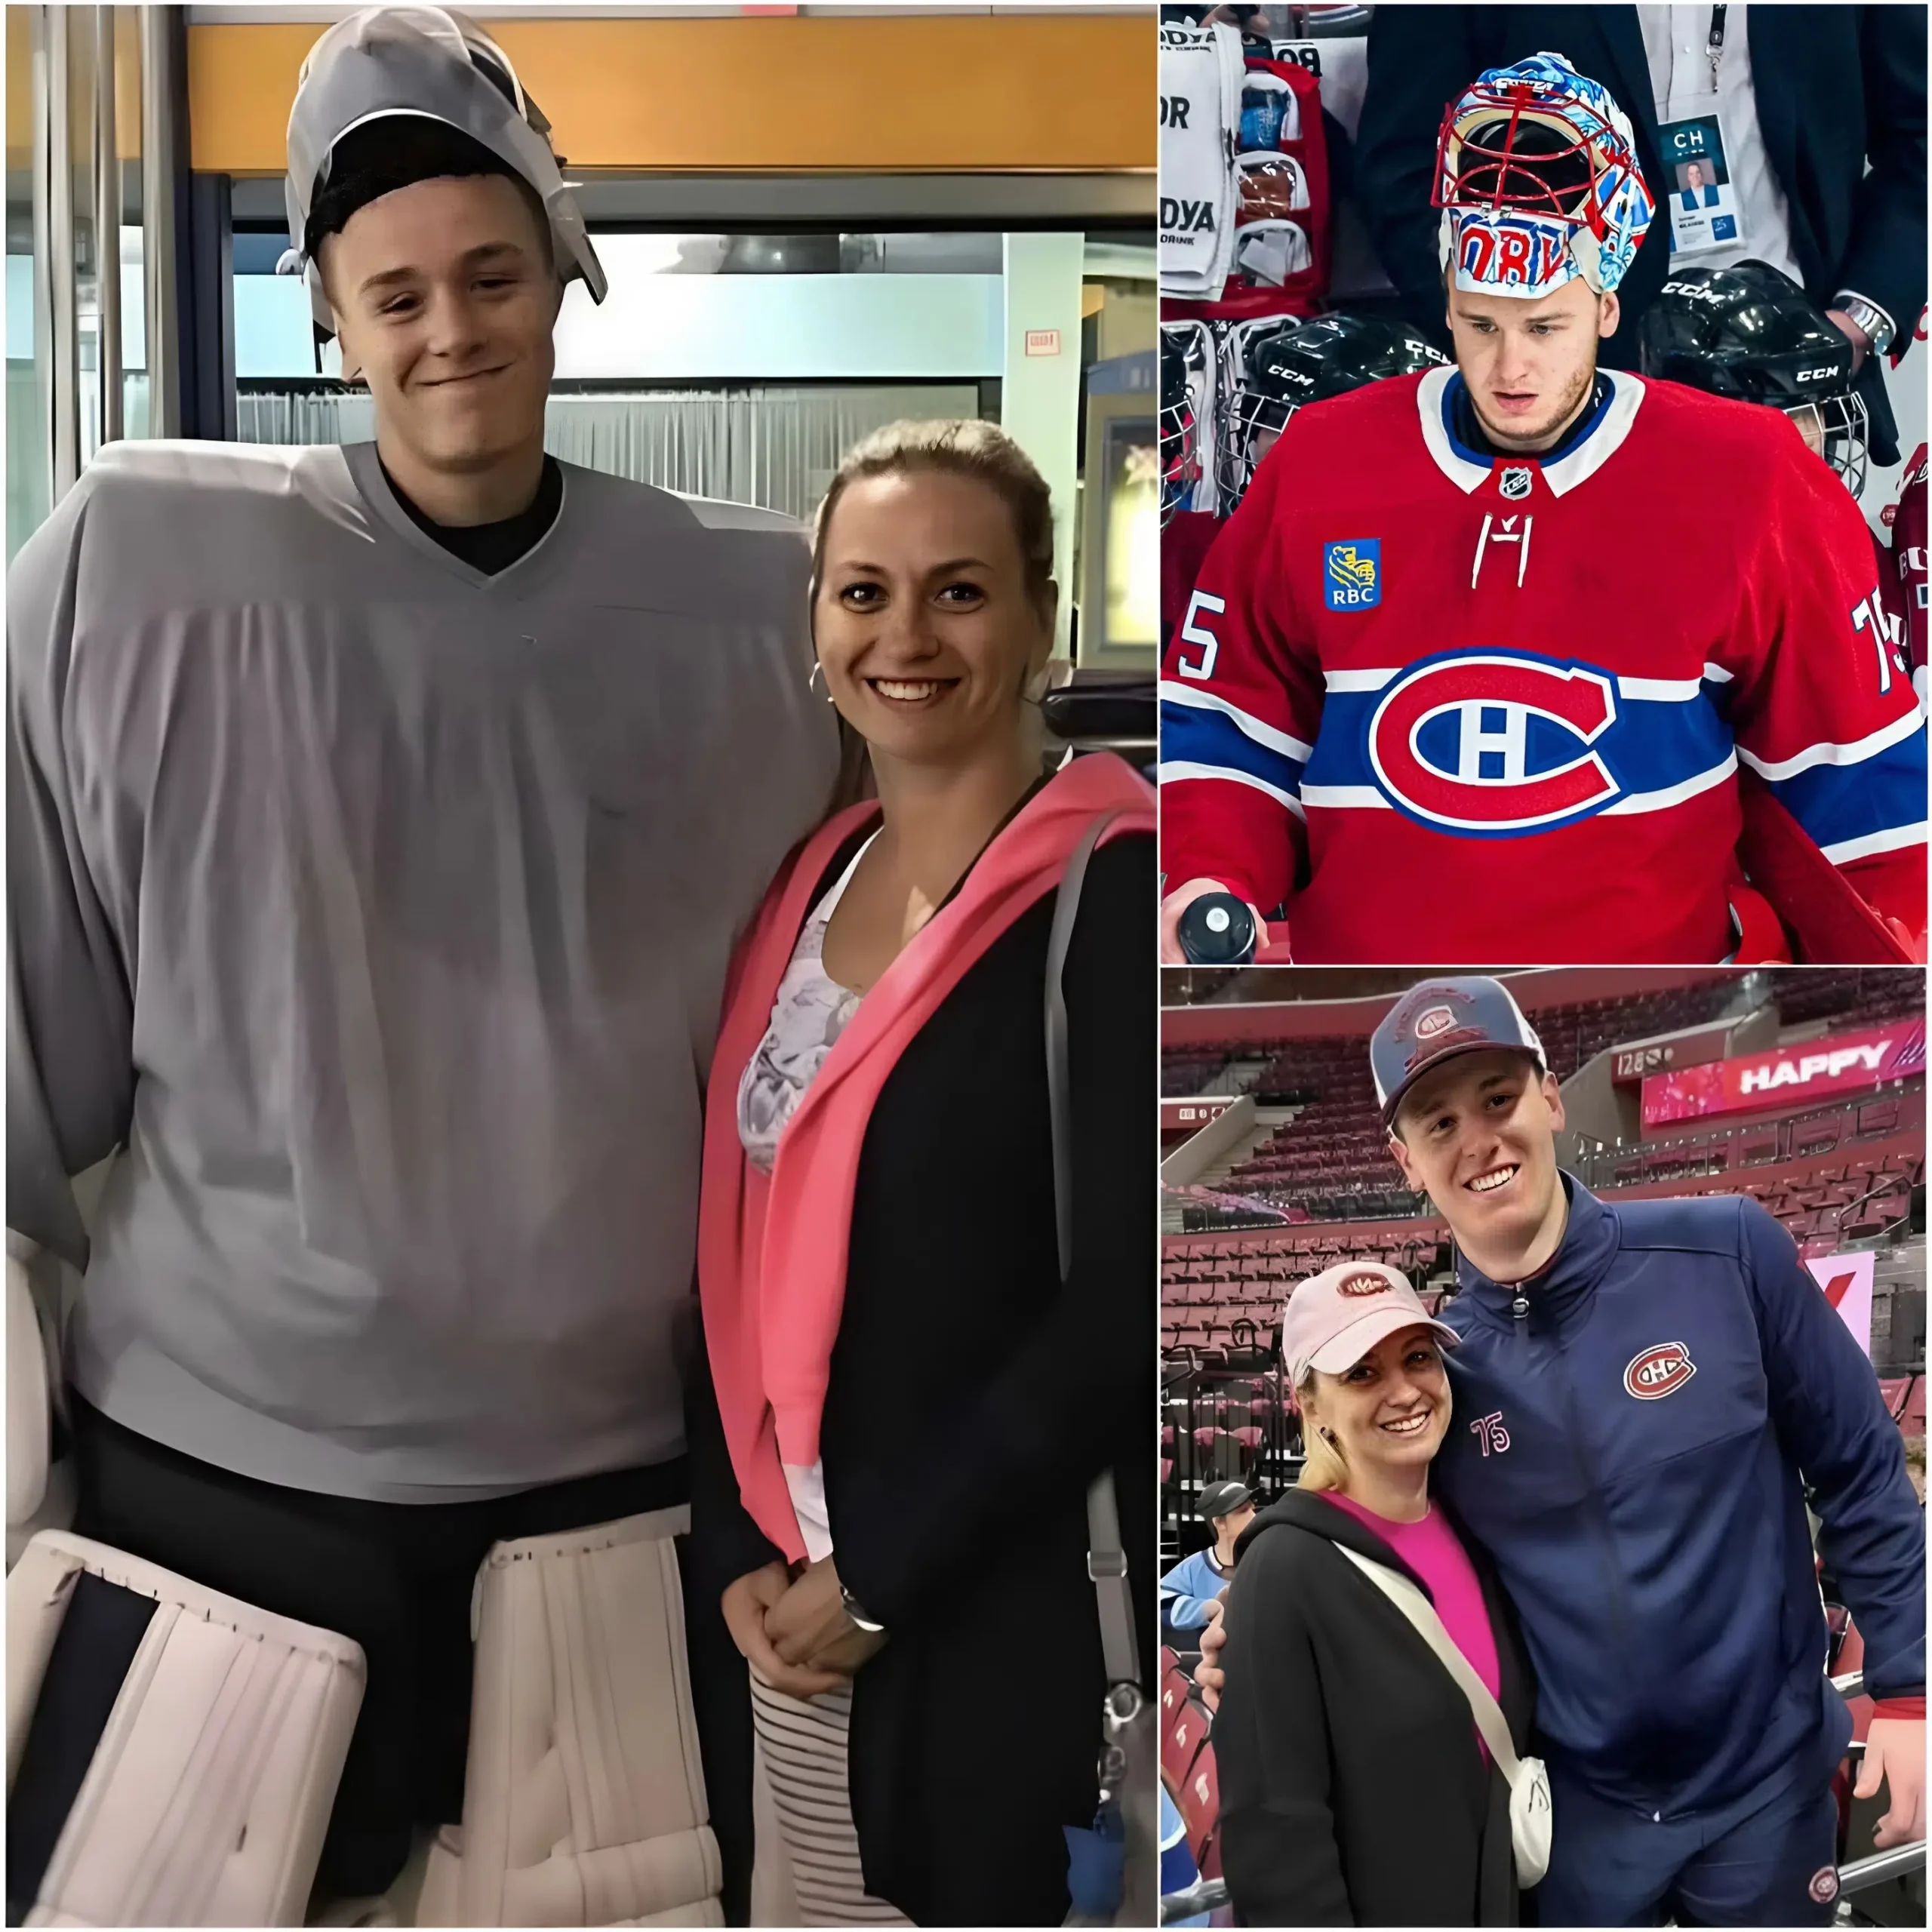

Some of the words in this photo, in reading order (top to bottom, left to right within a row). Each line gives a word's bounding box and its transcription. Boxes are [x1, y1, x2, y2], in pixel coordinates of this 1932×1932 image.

[1661, 281, 1726, 305] CCM
[1268, 365, 1315, 386] CCM
[1796, 365, 1839, 382] CCM
[1333, 588, 1374, 605] RBC
[1178, 588, 1226, 681] 5
[1617, 1051, 1644, 1075] 128
[1740, 1040, 1892, 1094] HAPPY
[1470, 1411, 1510, 1457] 75
